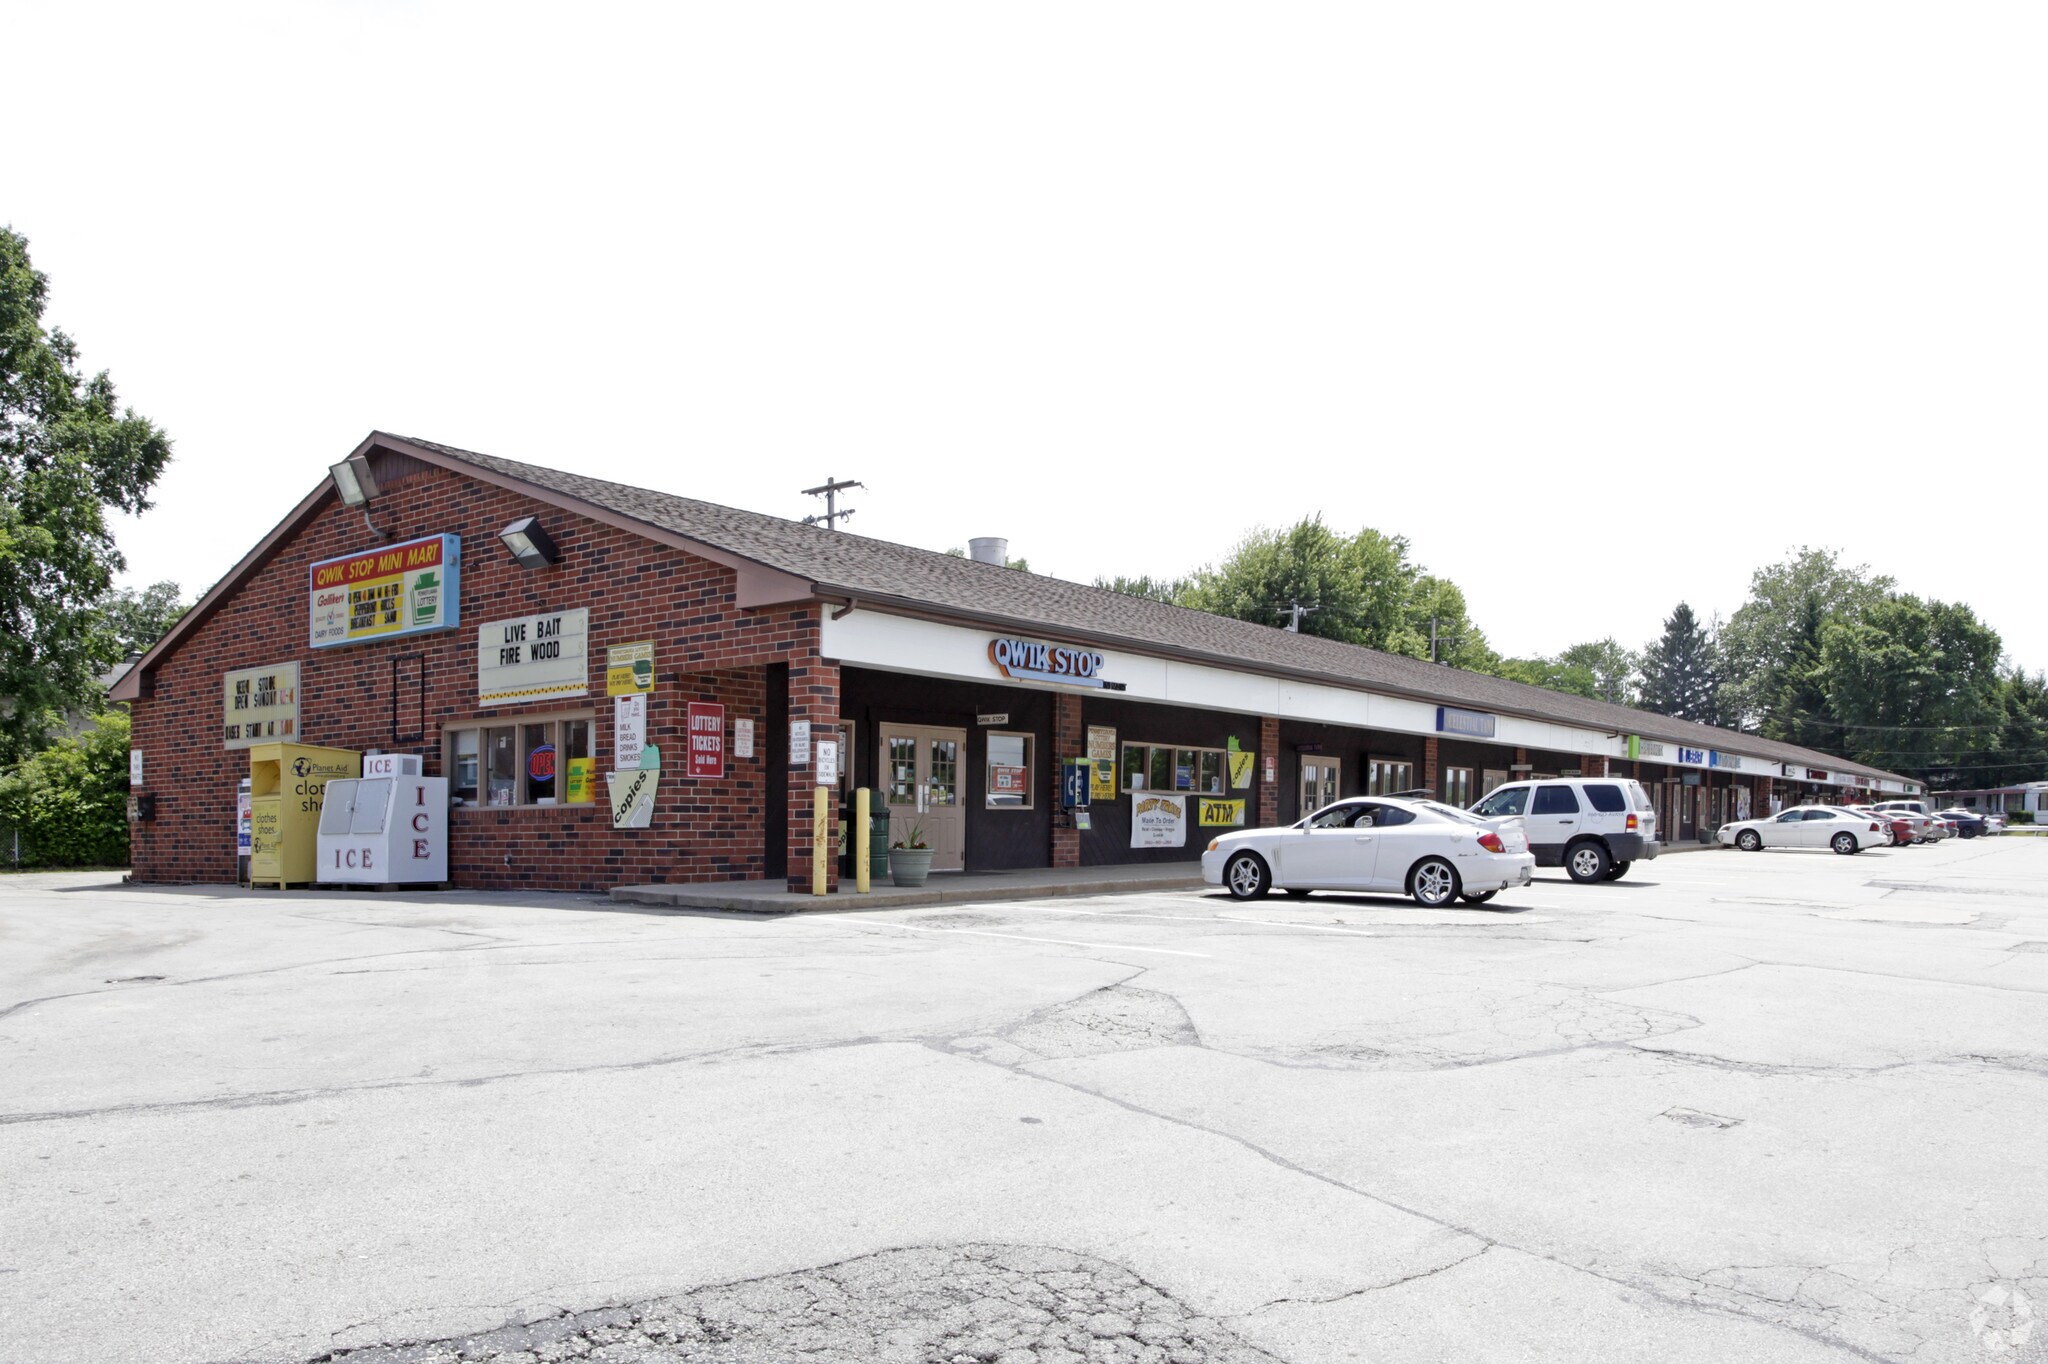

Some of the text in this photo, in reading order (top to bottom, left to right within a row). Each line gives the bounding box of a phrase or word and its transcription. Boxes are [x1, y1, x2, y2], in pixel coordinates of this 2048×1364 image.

[318, 544, 438, 585] QWIK STOP MINI MART
[417, 596, 437, 606] LOTTERY
[315, 627, 344, 638] DAIRY FOODS
[504, 617, 561, 643] LIVE BAIT
[500, 640, 560, 666] FIRE WOOD
[634, 651, 652, 659] GAMES
[989, 638, 1104, 678] QWIK STOP
[620, 723, 631, 731] MILK
[691, 715, 720, 732] LOTTERY
[620, 733, 636, 741] BREAD
[692, 734, 720, 752] TICKETS
[620, 743, 638, 752] DRINKS
[823, 748, 830, 756] NO
[1088, 741, 1115, 750] NUMBERS
[620, 754, 640, 762] SMOKES
[695, 754, 717, 764] Sold Here
[1092, 750, 1112, 758] GAMES
[312, 764, 348, 772] Planet Aid
[368, 758, 392, 774] ICE
[1232, 753, 1249, 784] copies
[295, 780, 326, 796] clot
[614, 770, 648, 824] copies
[1136, 798, 1160, 817] PARTY
[1204, 804, 1233, 822] ATM
[257, 812, 276, 823] clothes
[411, 785, 431, 860] ICE
[258, 824, 274, 834] shoes
[335, 848, 373, 870] ICE
